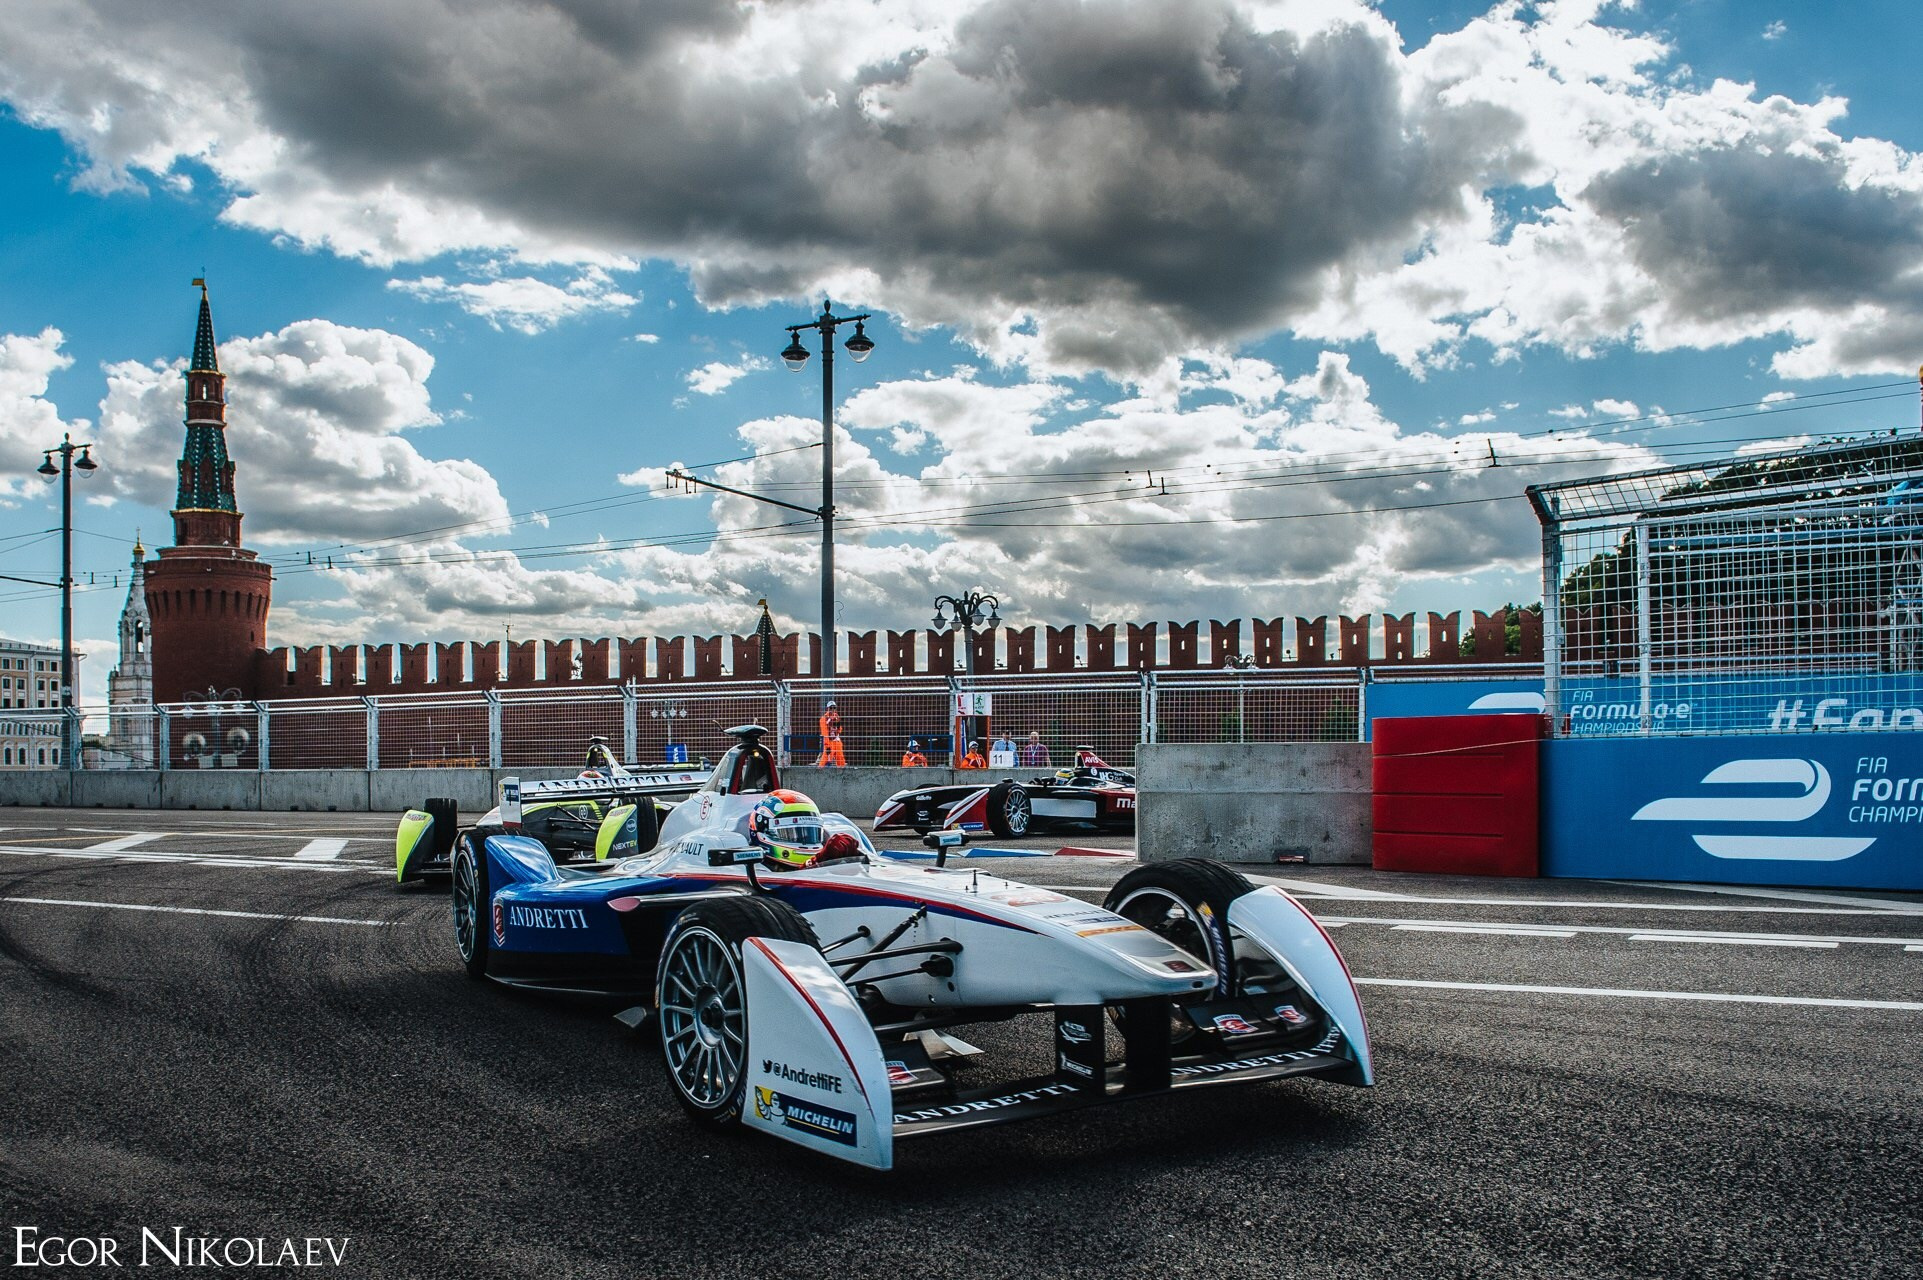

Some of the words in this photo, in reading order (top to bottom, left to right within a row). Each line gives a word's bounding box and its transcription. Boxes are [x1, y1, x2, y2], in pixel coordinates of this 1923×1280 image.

[1572, 690, 1594, 703] FIA
[993, 754, 1003, 764] 11
[1084, 756, 1099, 764] AVIS
[1856, 757, 1888, 774] FIA
[537, 774, 671, 792] ANDRETTI
[1099, 771, 1114, 781] IHG
[509, 905, 589, 929] ANDRETTI
[773, 1062, 842, 1094] @AndrettiFE
[893, 1084, 1080, 1124] ANDRETTI
[787, 1106, 854, 1134] MICHELIN
